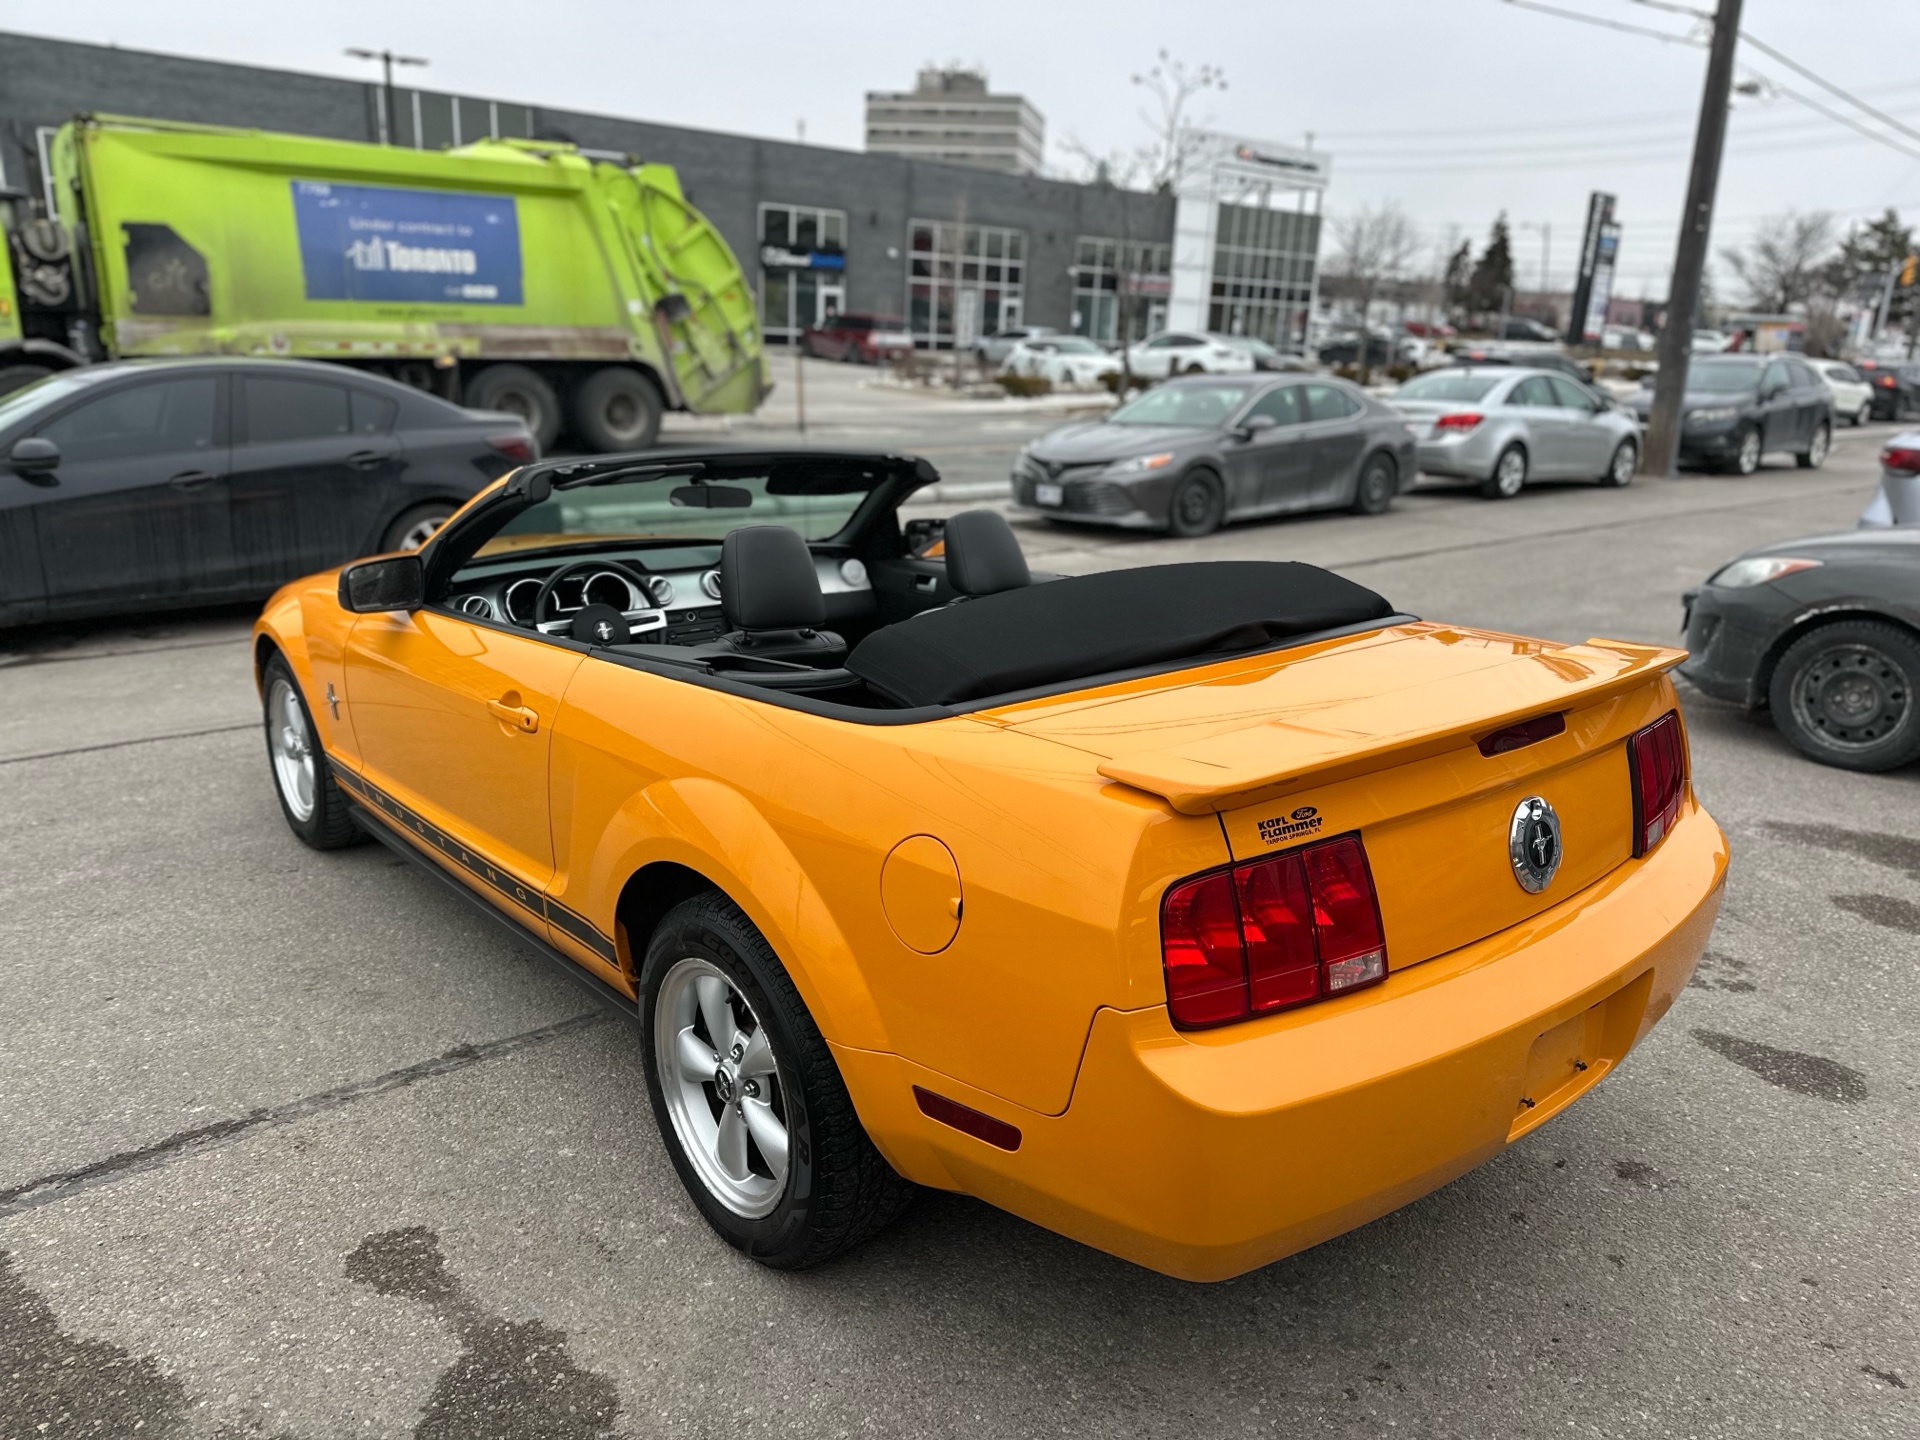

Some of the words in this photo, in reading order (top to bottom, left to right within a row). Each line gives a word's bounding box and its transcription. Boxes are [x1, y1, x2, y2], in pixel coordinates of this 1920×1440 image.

[349, 216, 394, 232] Under
[397, 220, 455, 235] contract
[457, 224, 473, 237] to
[375, 792, 527, 901] MUSTANG
[1265, 835, 1288, 846] TARPON
[1289, 829, 1314, 840] SPRINGS,
